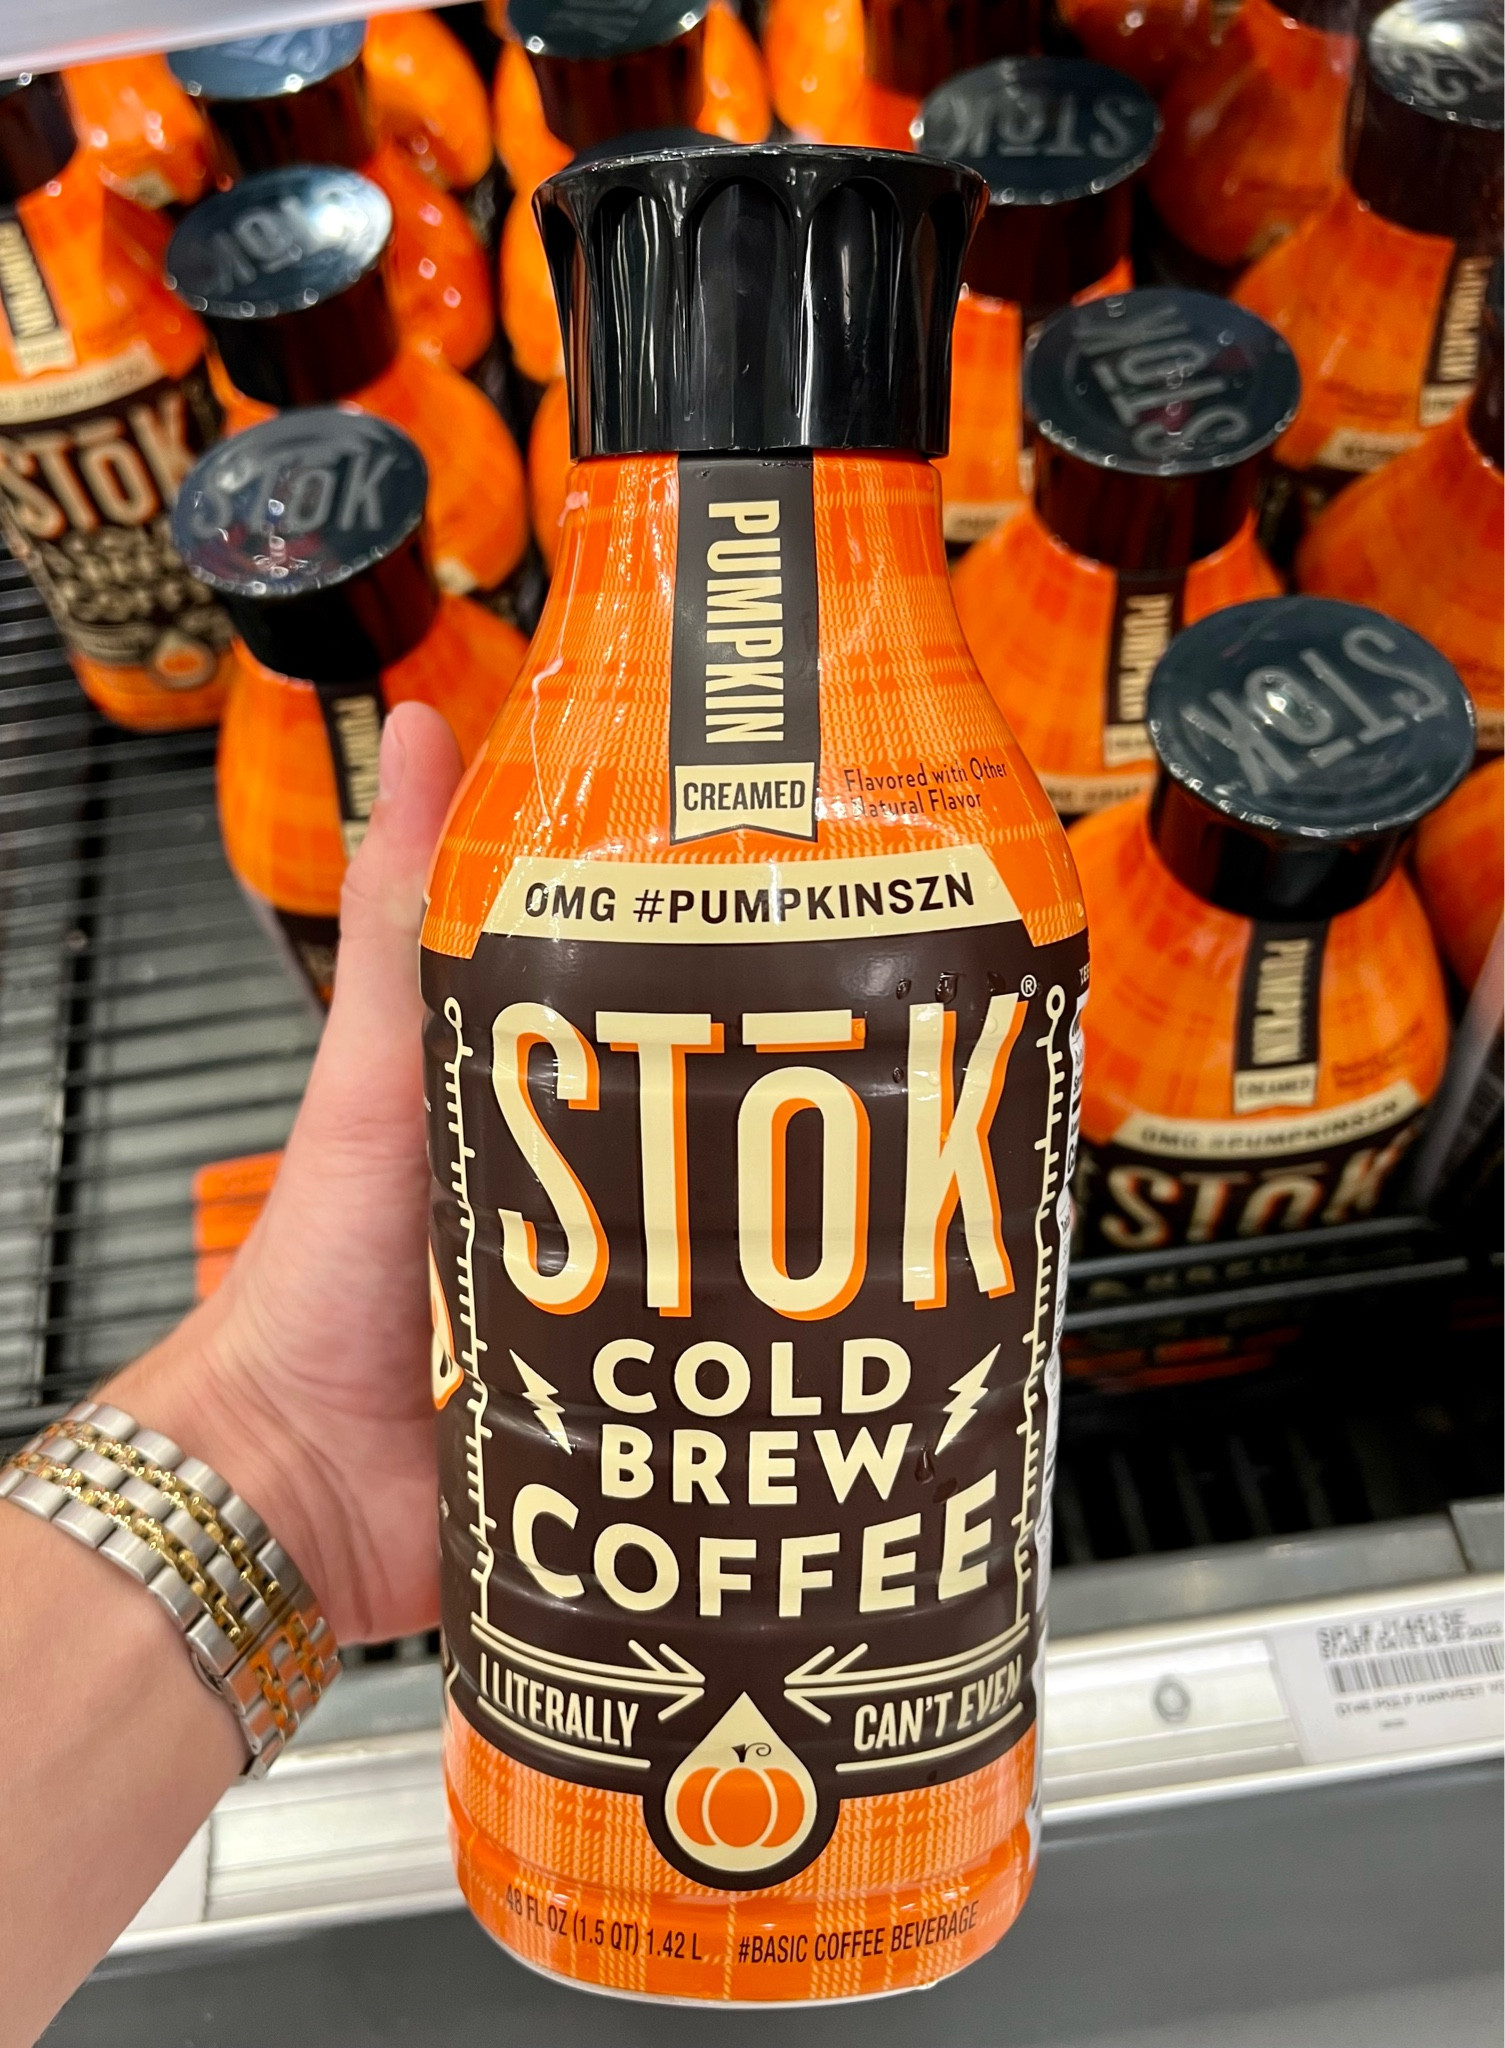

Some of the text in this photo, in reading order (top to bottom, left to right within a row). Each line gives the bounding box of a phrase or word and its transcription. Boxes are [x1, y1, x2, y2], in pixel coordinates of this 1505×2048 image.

[704, 500, 785, 744] PUMPKIN
[683, 779, 806, 811] CREAMED
[844, 756, 1007, 792] Flavored with Other
[851, 788, 981, 818] Natural Flavor
[524, 871, 976, 924] OMG #PUMPKINSZN
[592, 1338, 911, 1417] COLD
[601, 1423, 912, 1504] BREW
[512, 1470, 996, 1617] COFFEE
[492, 1661, 639, 1748] LITERALLY
[854, 1653, 1023, 1751] CAN'T EVEN
[505, 1883, 702, 1961] 48 FL OZ (1.5 QT) 1.42 L
[738, 1899, 980, 1963] #BASIC COFFEE BEVERAGE
